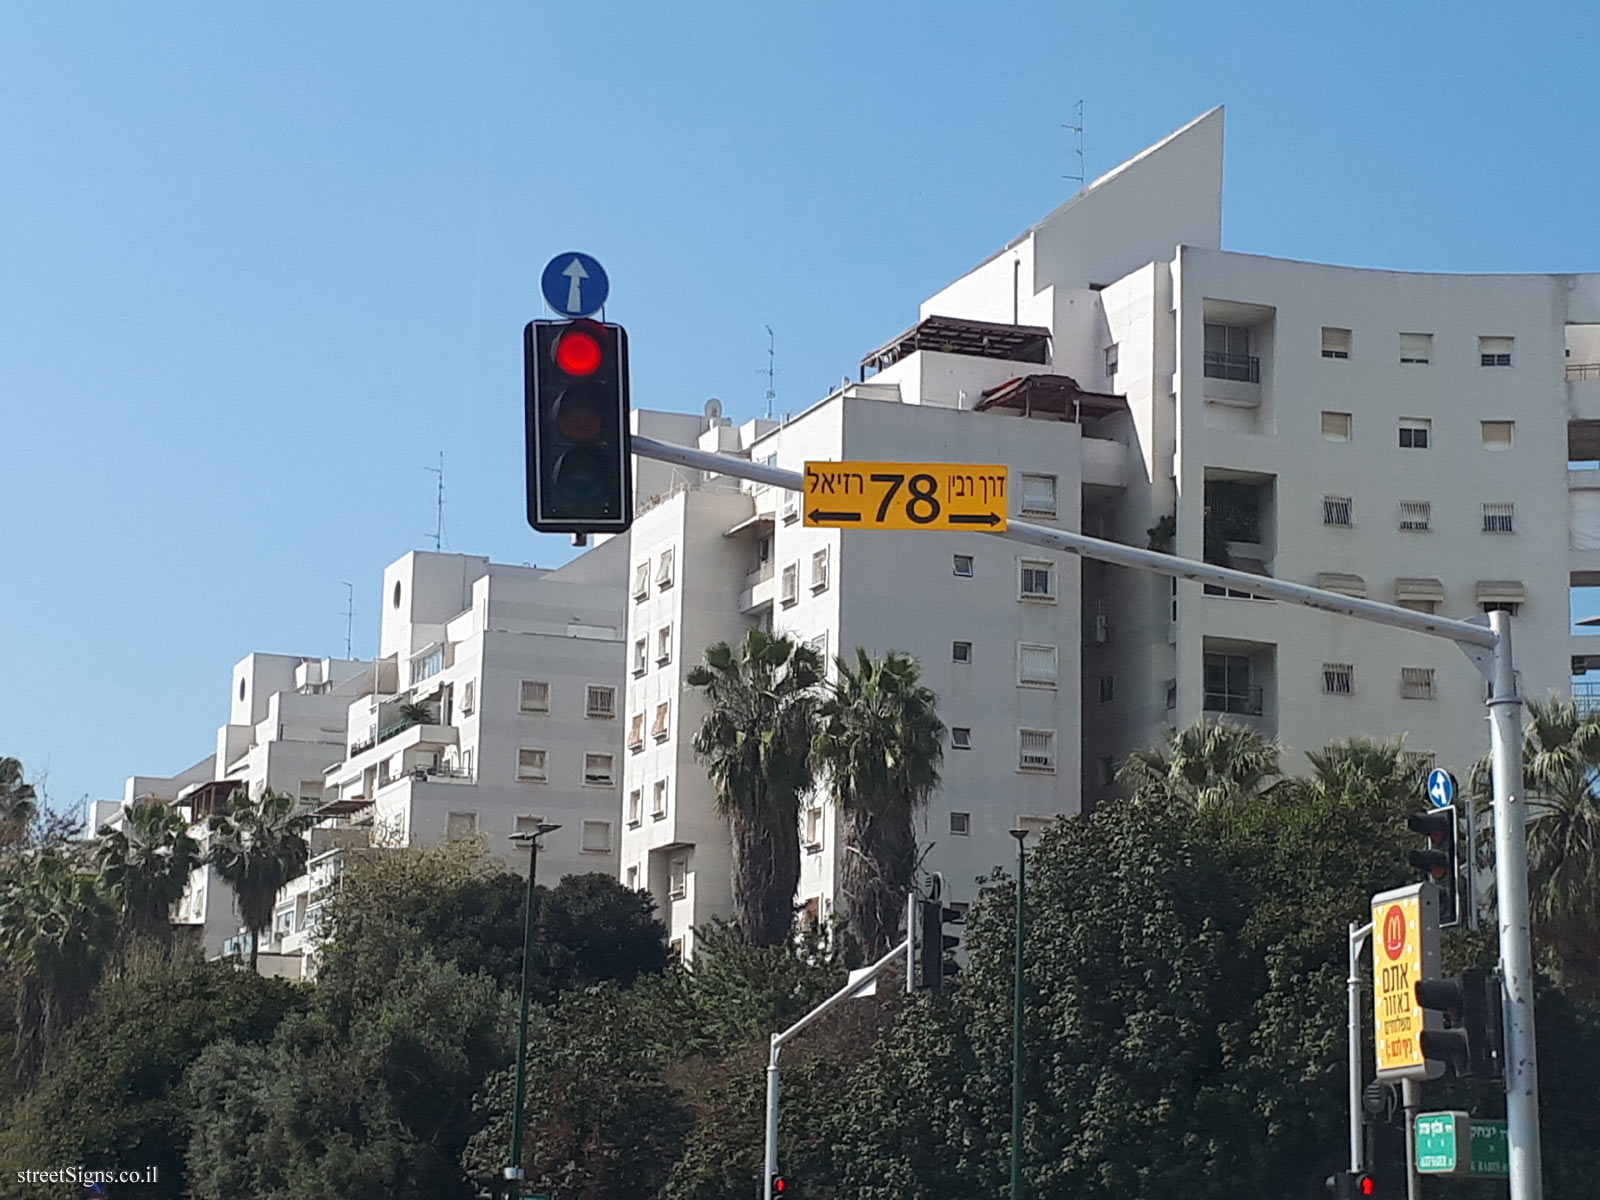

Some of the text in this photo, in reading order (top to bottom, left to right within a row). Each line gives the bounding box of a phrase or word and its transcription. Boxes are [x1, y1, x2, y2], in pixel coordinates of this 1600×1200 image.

[806, 466, 864, 495] רזיאל
[947, 475, 1005, 504] דרך רבין
[870, 474, 941, 524] 78
[1382, 962, 1409, 994] אתם
[1383, 991, 1410, 1017] באזור
